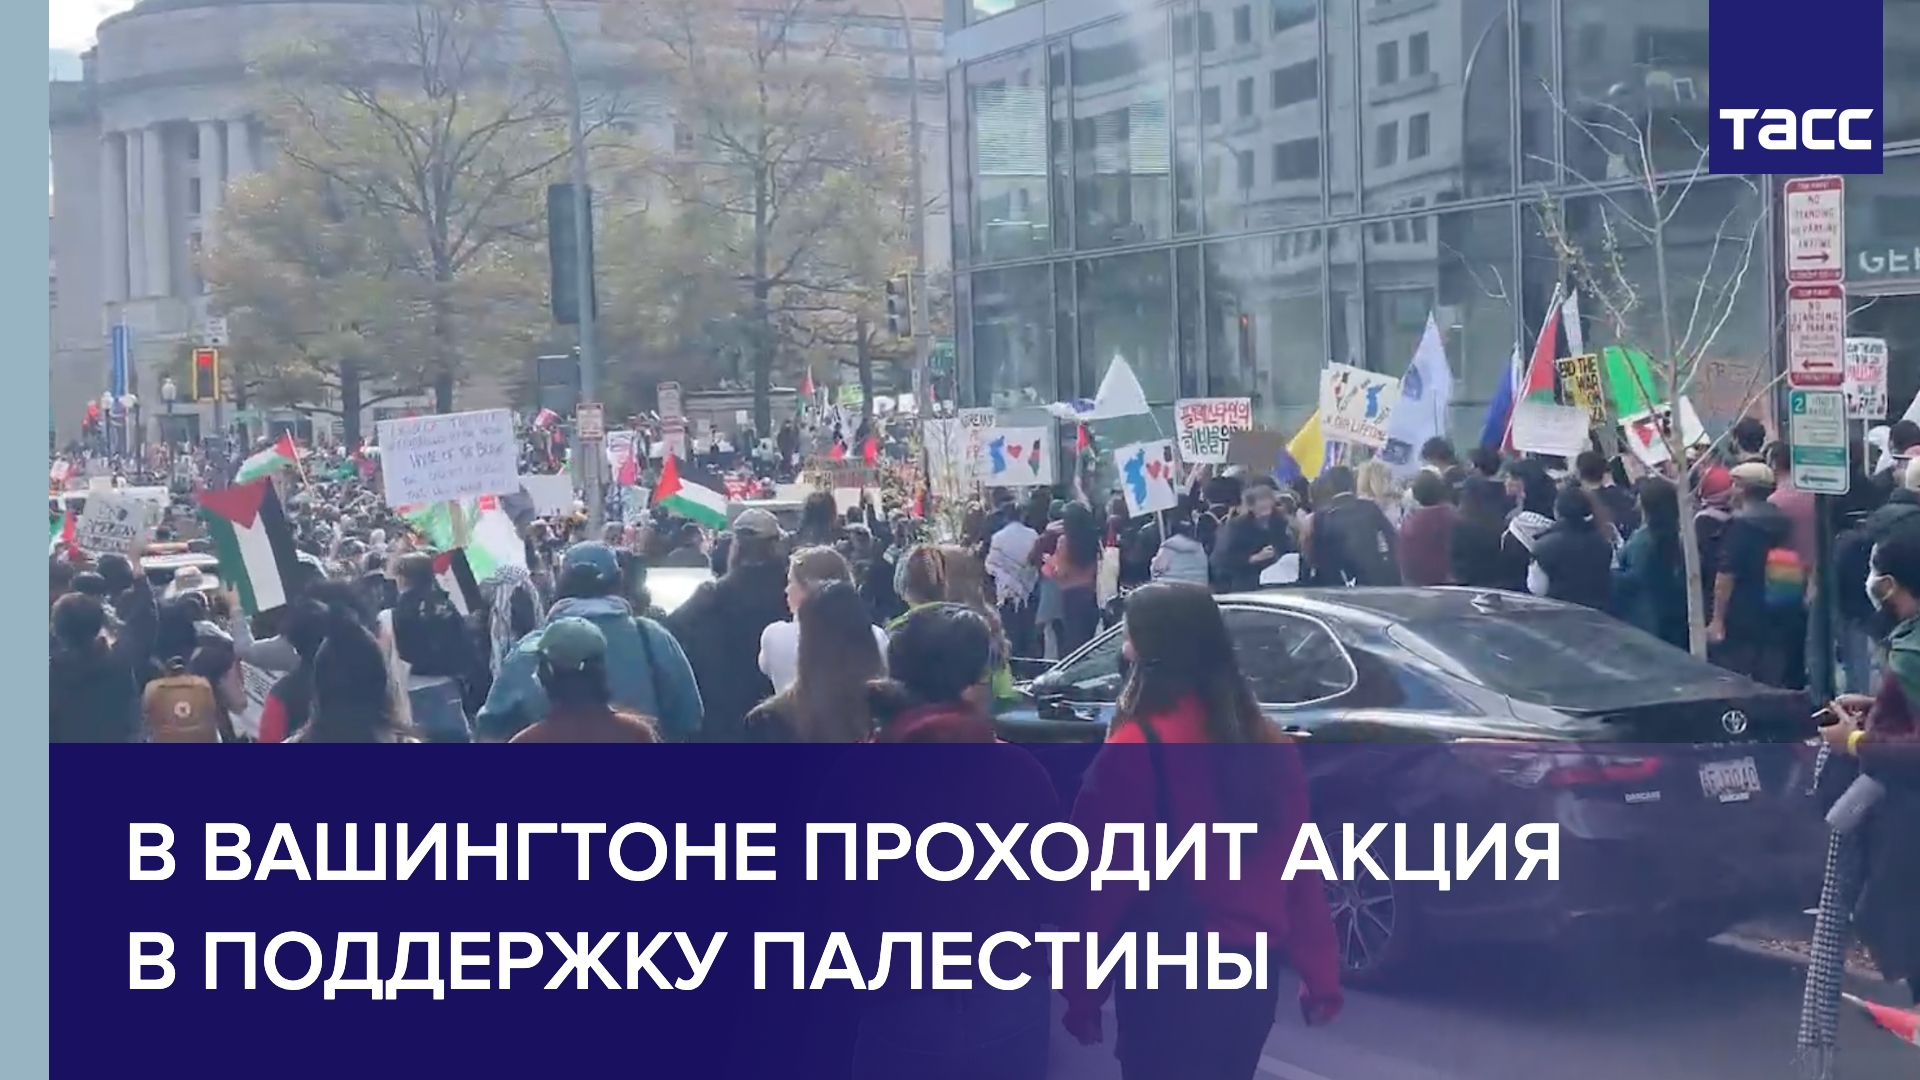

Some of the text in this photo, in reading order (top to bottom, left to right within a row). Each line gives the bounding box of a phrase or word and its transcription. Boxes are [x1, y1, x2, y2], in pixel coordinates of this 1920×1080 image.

[1808, 194, 1820, 204] NO
[1808, 301, 1821, 311] NO
[1791, 311, 1839, 322] STANDING
[1577, 356, 1597, 374] THE
[1575, 373, 1599, 391] WAR
[1794, 397, 1804, 413] 2
